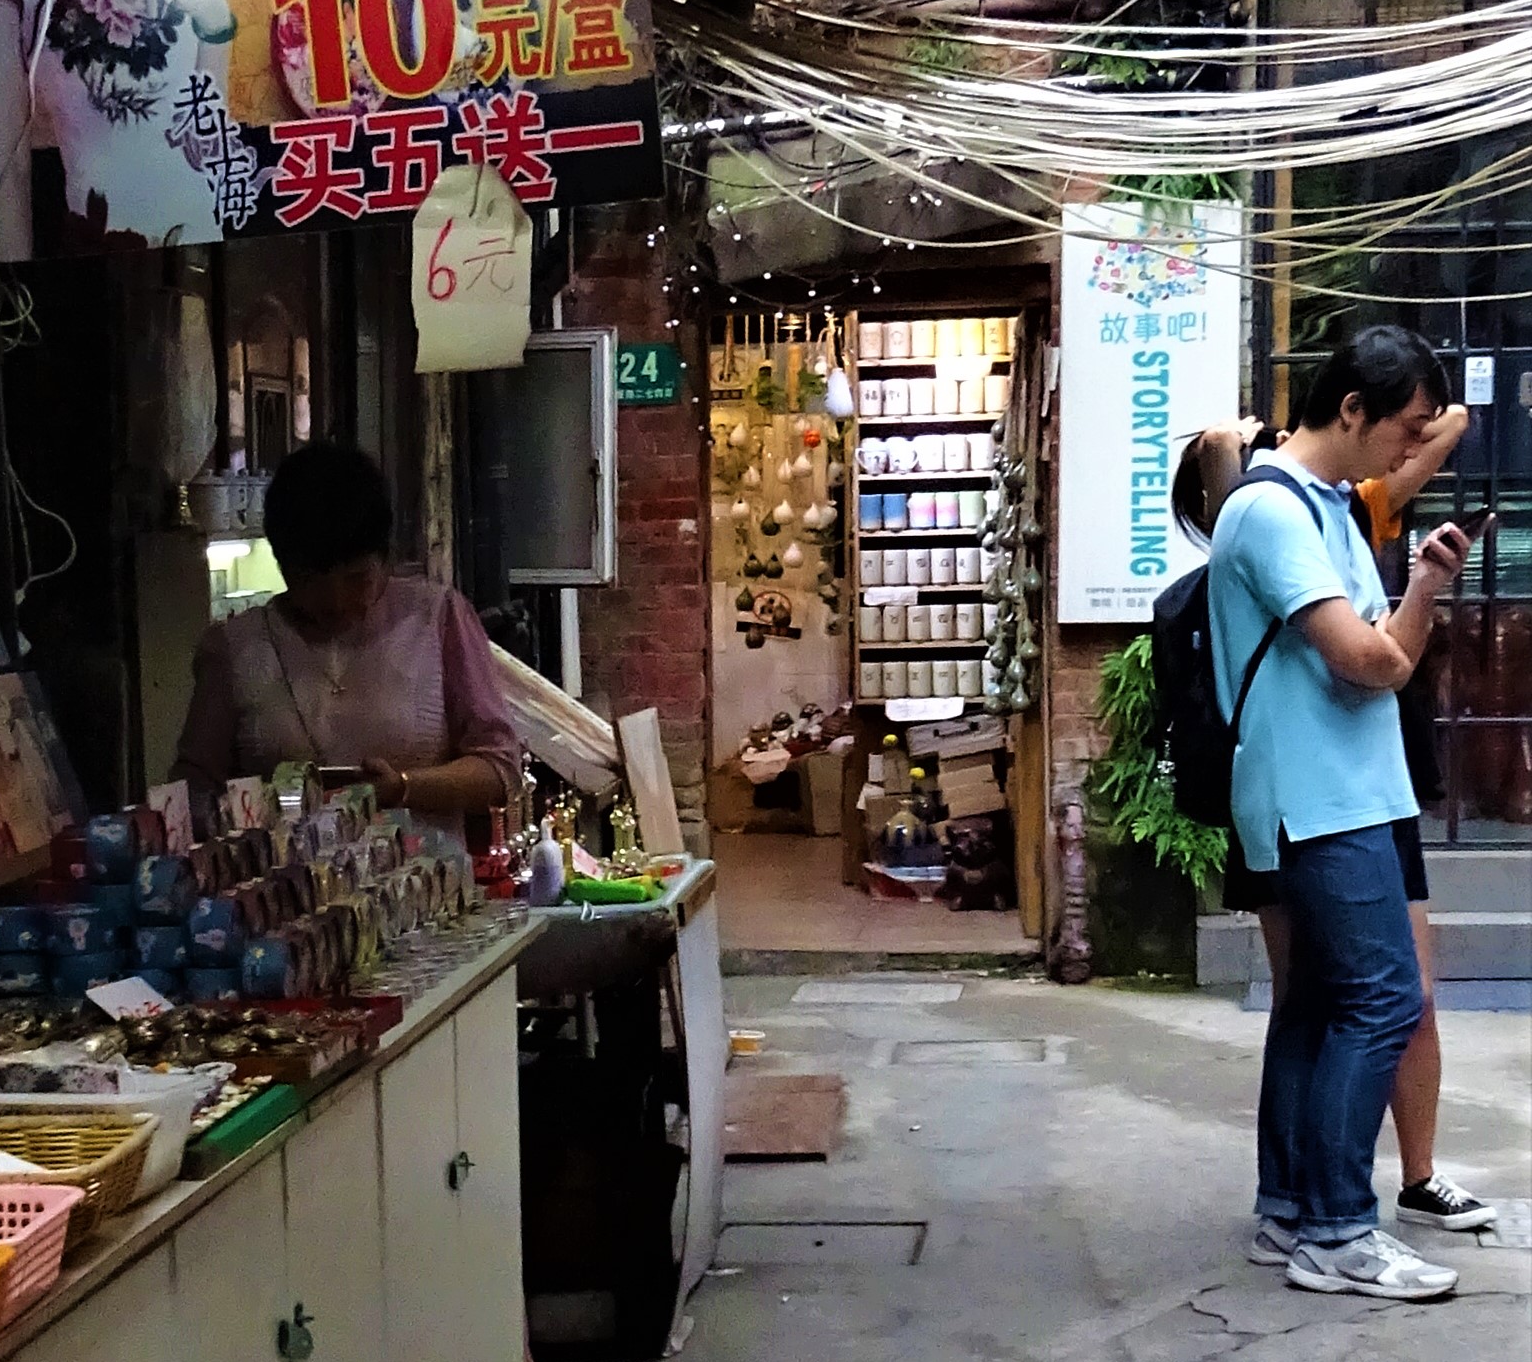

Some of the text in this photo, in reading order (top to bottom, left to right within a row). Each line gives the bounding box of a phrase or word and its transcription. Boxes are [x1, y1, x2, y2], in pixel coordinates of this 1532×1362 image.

[269, 92, 644, 228] 买五送一
[620, 350, 659, 383] 24
[1129, 350, 1170, 577] STORYTELLING
